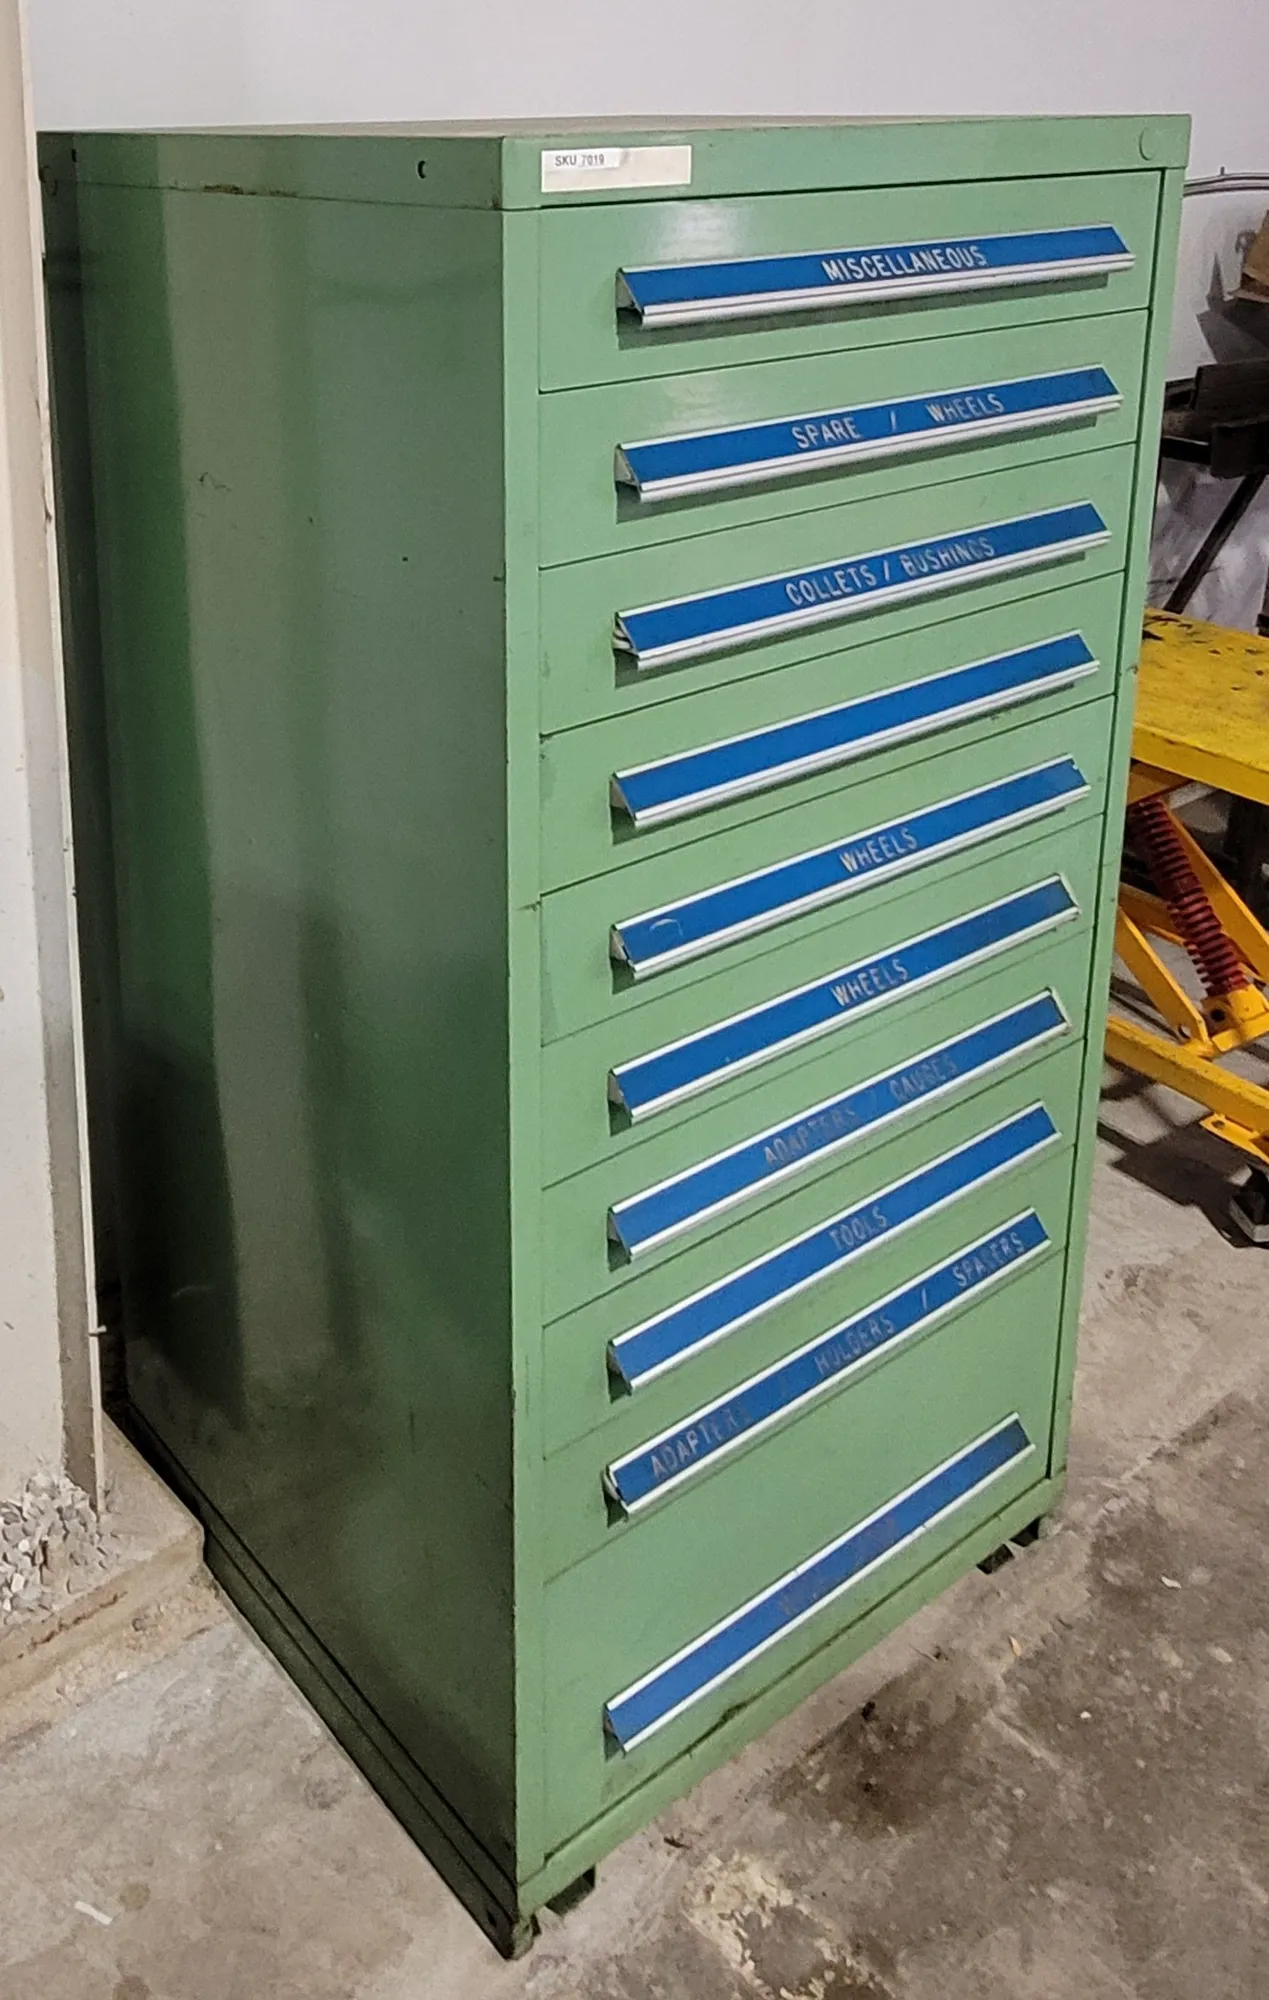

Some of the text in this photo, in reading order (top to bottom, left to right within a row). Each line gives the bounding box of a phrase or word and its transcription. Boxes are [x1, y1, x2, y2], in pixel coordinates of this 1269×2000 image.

[554, 154, 577, 167] SKU
[821, 245, 988, 282] MISCELLANEOUS
[791, 392, 1005, 449] SPARE / WHEELS
[785, 536, 995, 606] COLLETS / BUSHINGS
[839, 827, 917, 873] WHEELS
[830, 959, 908, 1007] WHEELS
[828, 1206, 887, 1251] TOOLS
